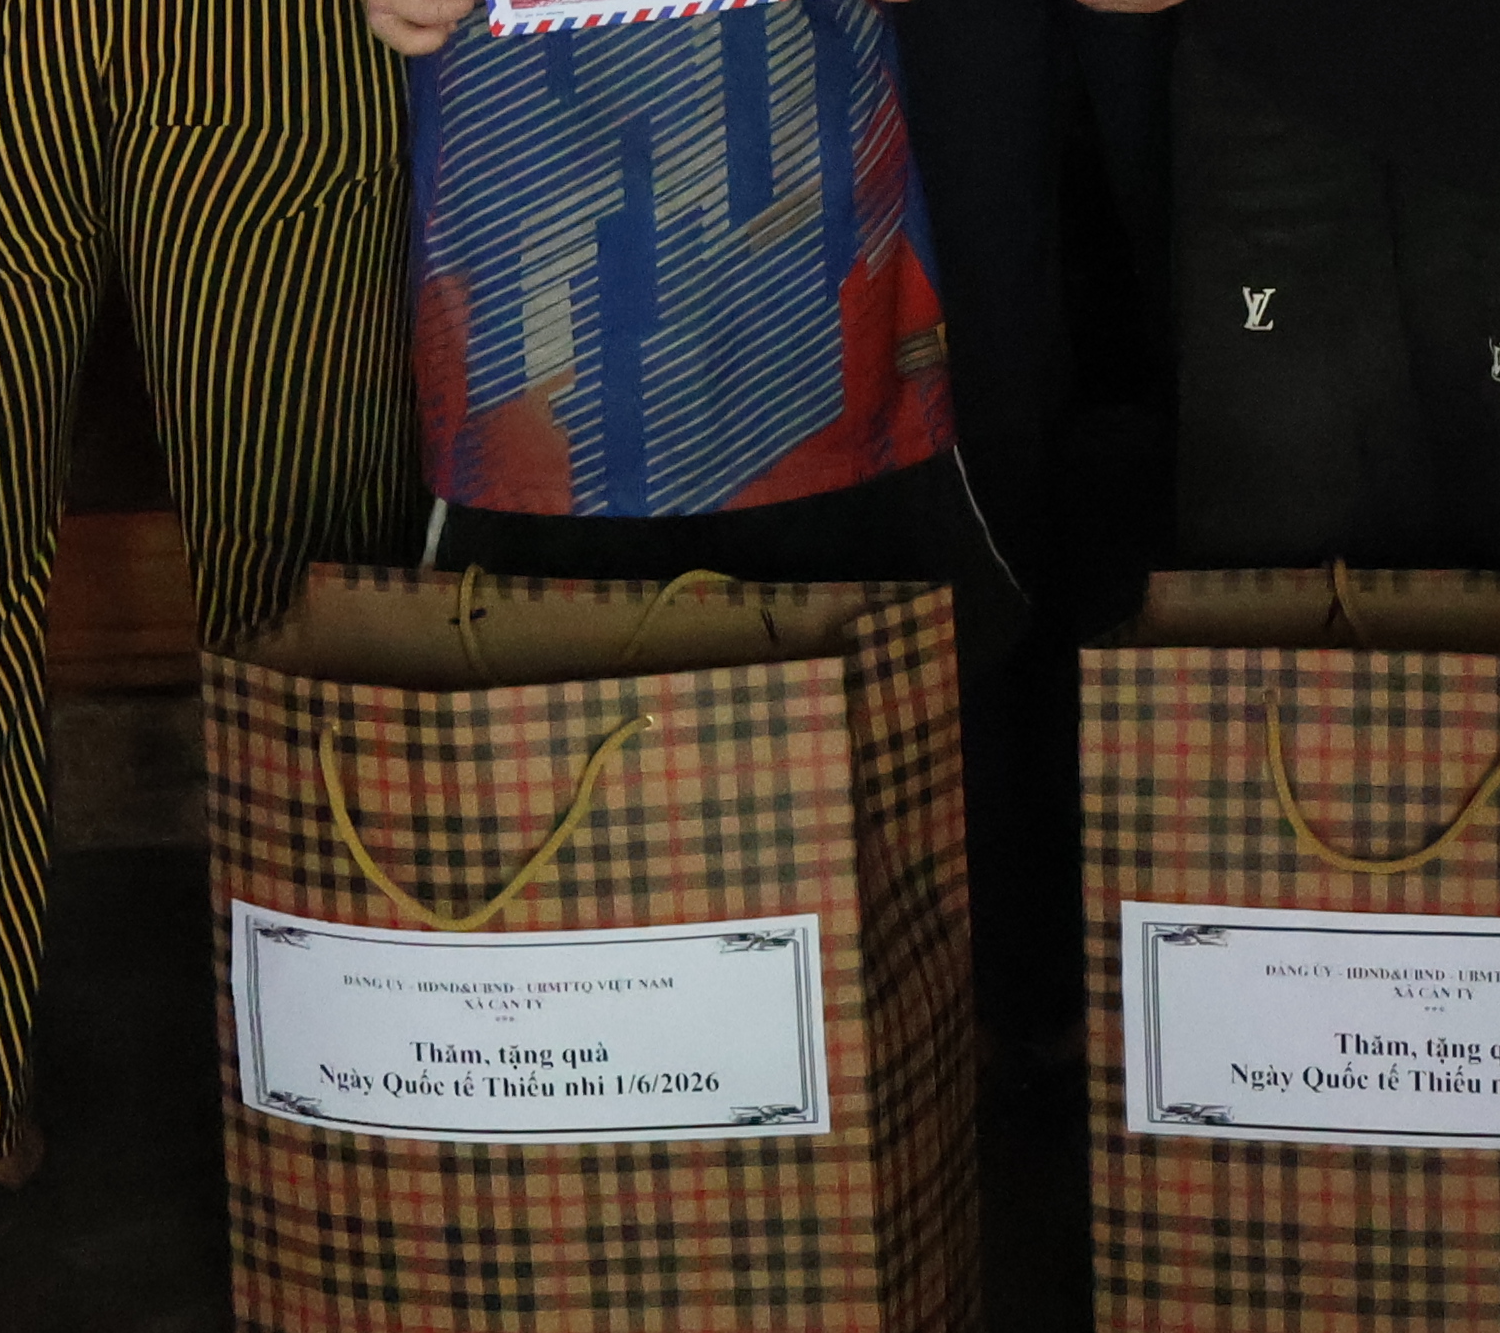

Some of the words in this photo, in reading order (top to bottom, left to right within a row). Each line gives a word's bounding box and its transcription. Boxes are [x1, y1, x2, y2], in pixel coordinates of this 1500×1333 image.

[639, 977, 674, 989] NAM
[410, 1040, 491, 1066] Thăm,
[498, 1043, 554, 1070] tặng
[562, 1040, 609, 1067] quà
[1334, 1033, 1417, 1059] Thăm,
[1426, 1036, 1482, 1064] tặng
[319, 1064, 375, 1096] Ngày
[383, 1068, 445, 1098] Quốc
[453, 1069, 475, 1097] tế
[483, 1069, 556, 1098] Thiếu
[565, 1075, 604, 1096] nhi
[616, 1071, 720, 1096] 1/6/2026
[1231, 1063, 1294, 1092] Ngày
[1302, 1061, 1368, 1091] Quốc
[1378, 1062, 1400, 1091] tế
[1408, 1065, 1481, 1095] Thiếu
